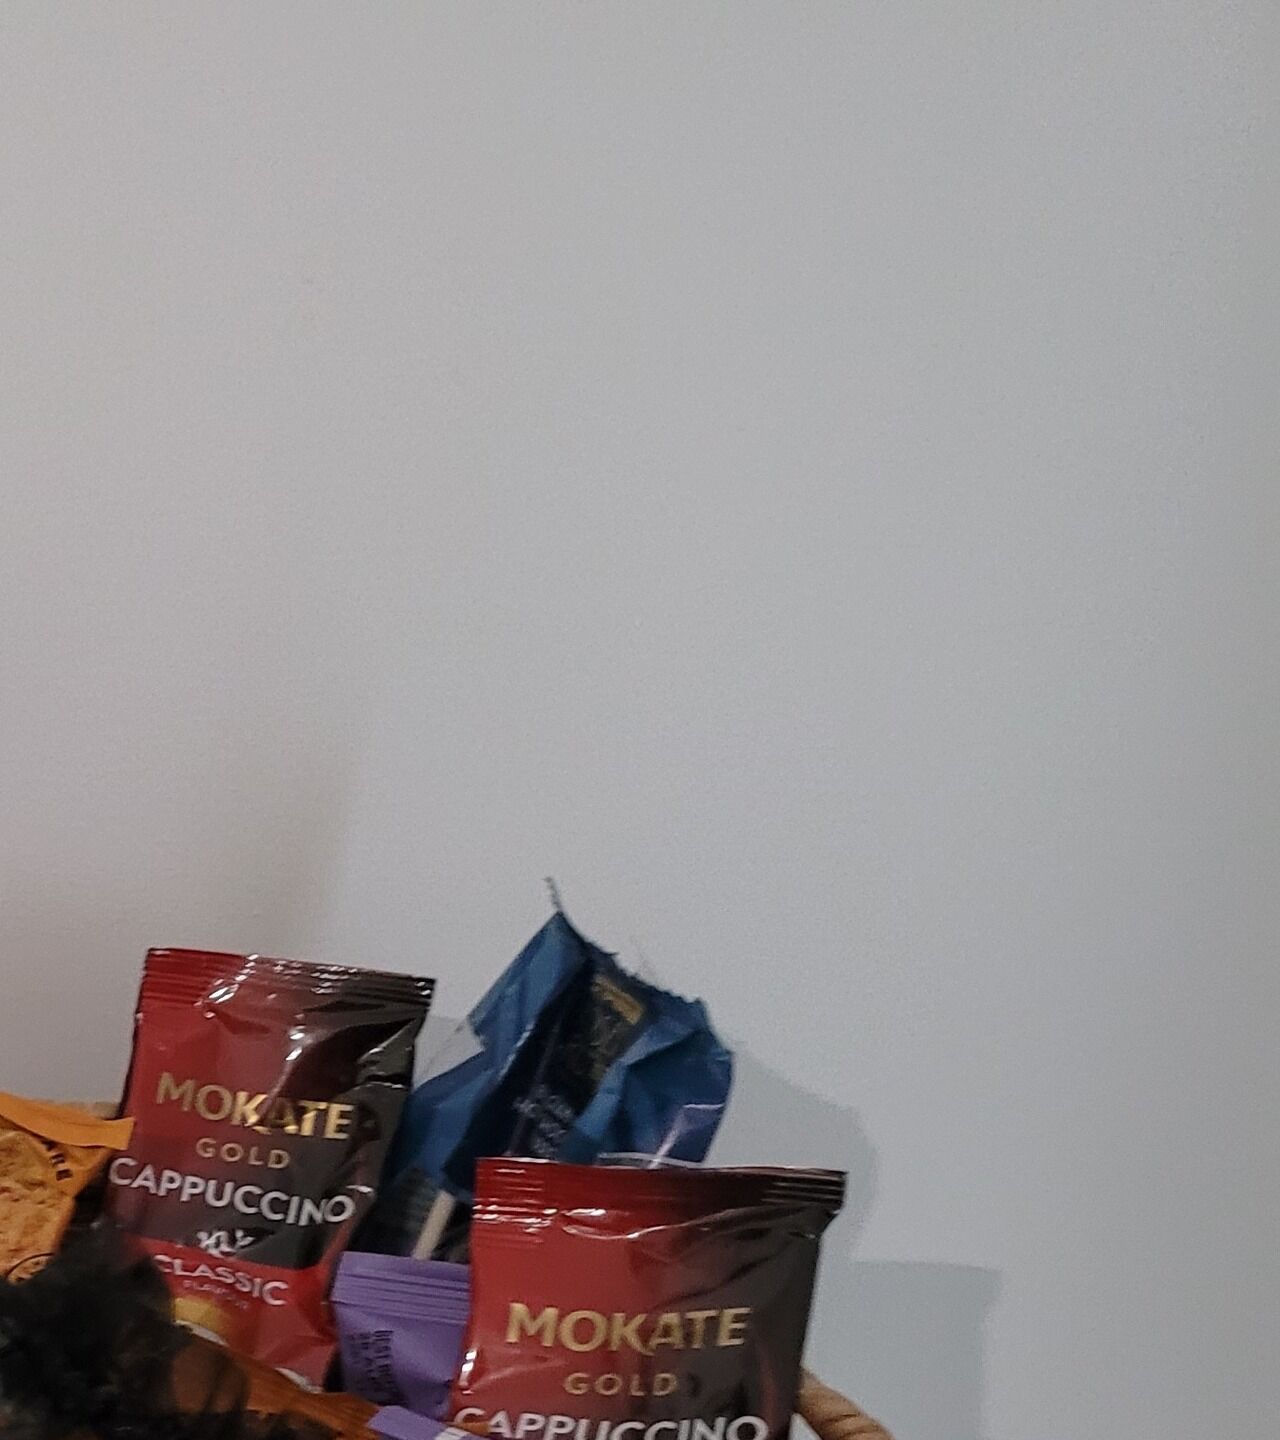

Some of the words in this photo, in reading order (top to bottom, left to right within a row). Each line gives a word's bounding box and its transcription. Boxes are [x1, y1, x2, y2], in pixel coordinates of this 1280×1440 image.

[157, 1072, 354, 1140] MOKATE
[195, 1138, 290, 1170] GOLD
[108, 1157, 356, 1227] CAPPUCCINO
[153, 1254, 289, 1306] CLASSIC
[506, 1302, 753, 1356] MOKATE
[563, 1372, 680, 1397] GOLD
